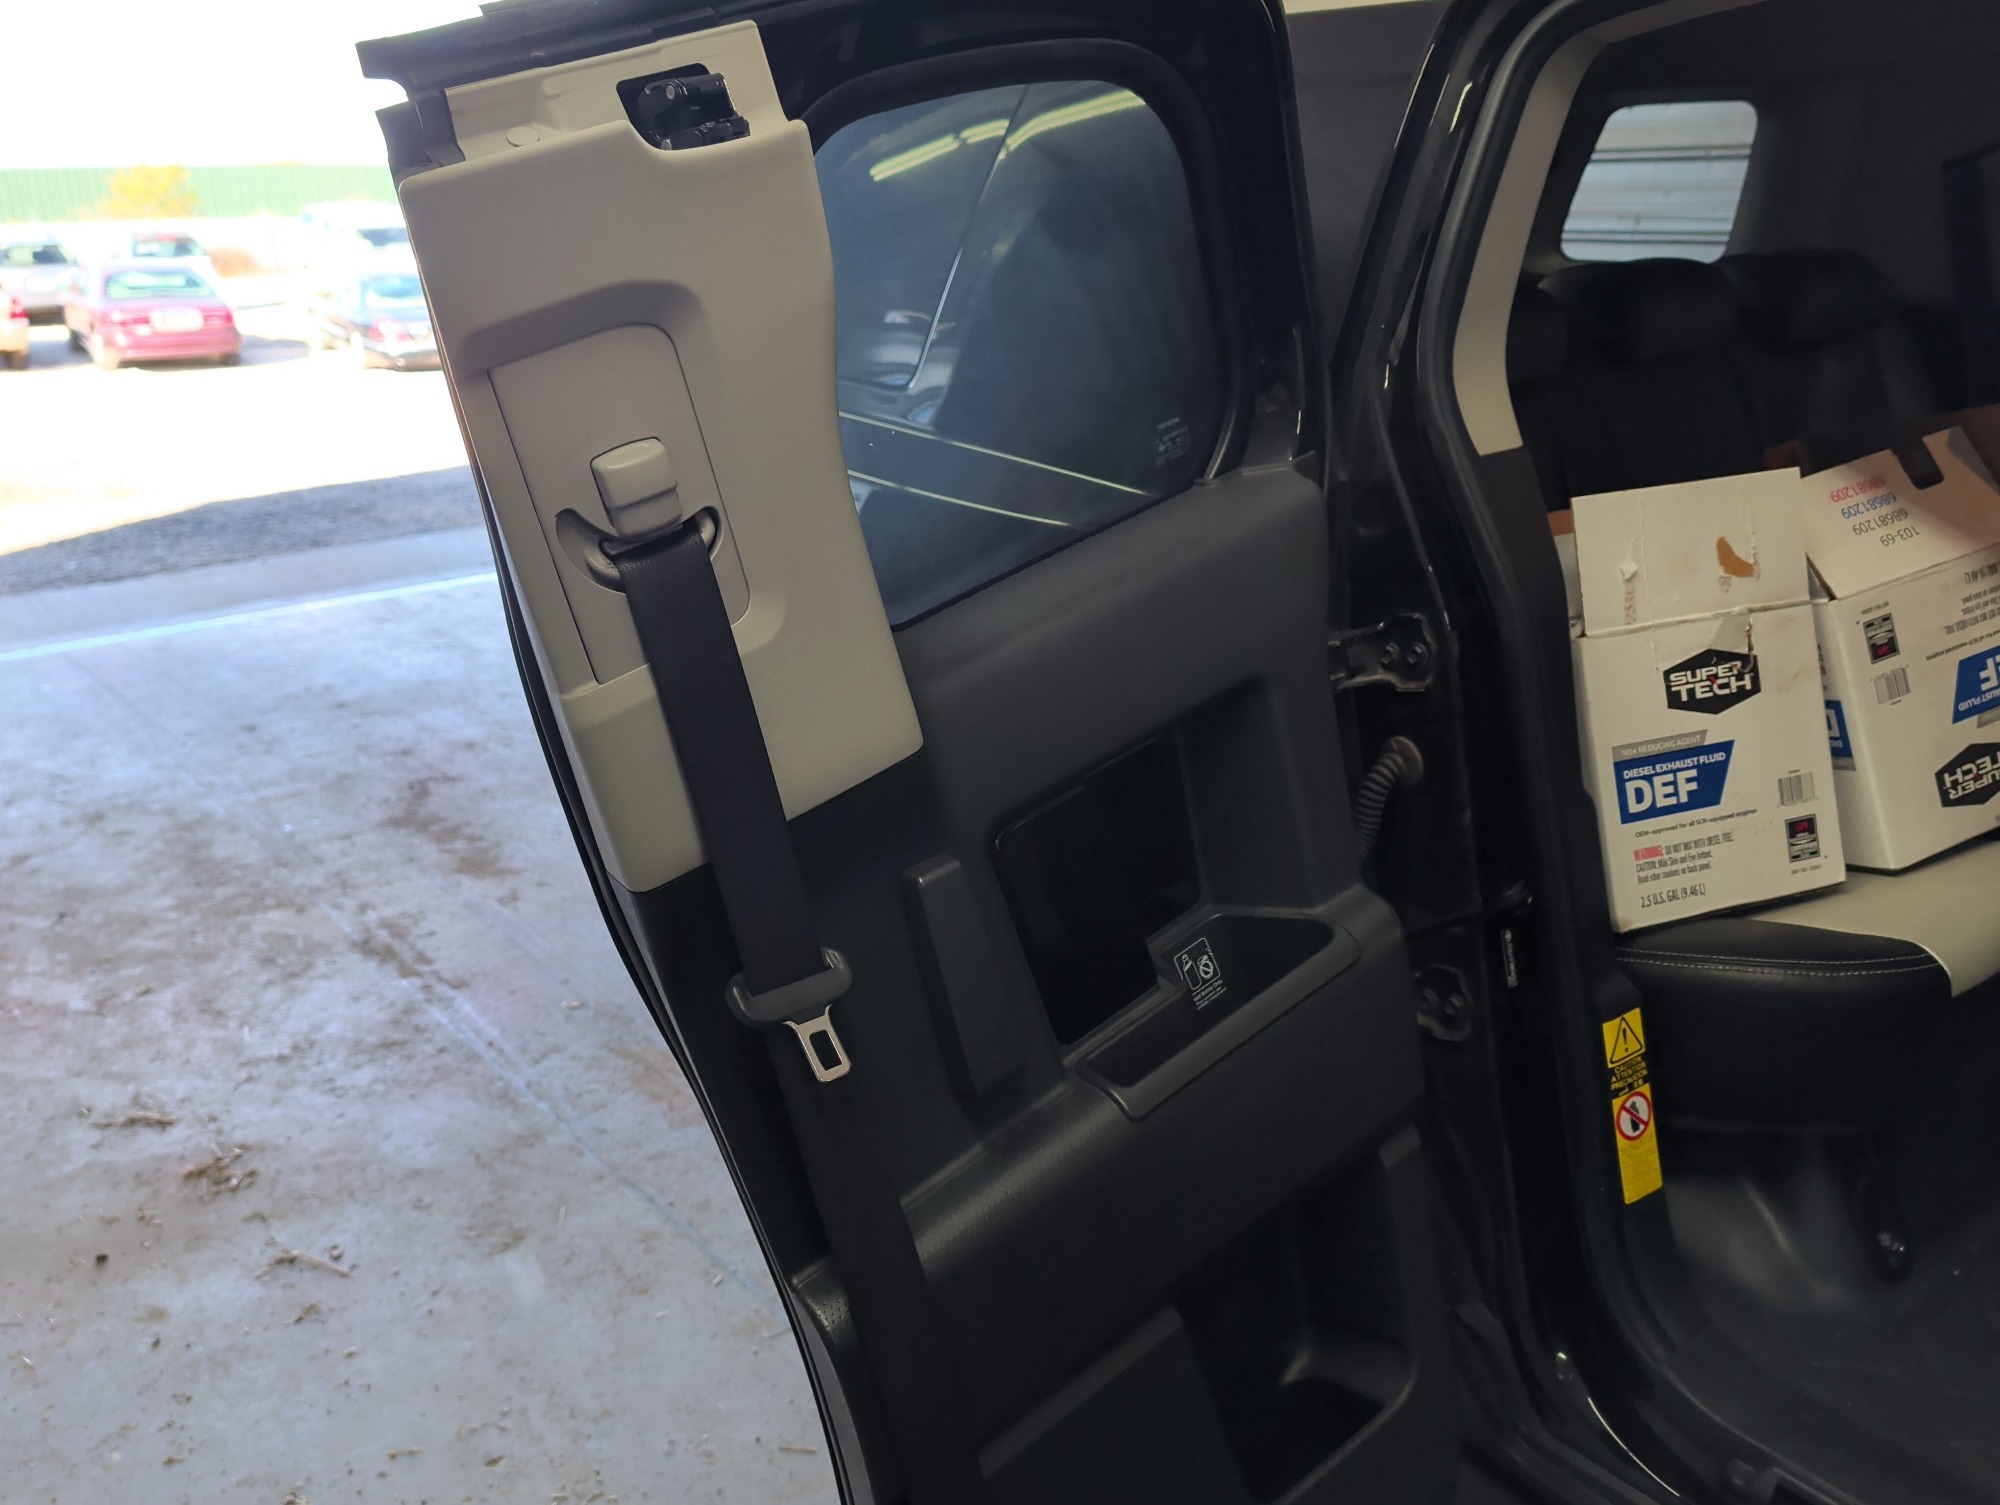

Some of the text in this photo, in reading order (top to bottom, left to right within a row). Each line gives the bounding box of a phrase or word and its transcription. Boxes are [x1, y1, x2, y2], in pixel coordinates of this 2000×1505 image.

[1841, 491, 1897, 519] 68681209
[1852, 508, 1908, 535] 68681209
[1880, 525, 1920, 547] 103-69
[1669, 661, 1743, 686] SUPER
[1671, 673, 1752, 702] TECH
[1958, 696, 1981, 711] FLUID
[1638, 740, 1676, 754] REDUCING
[1676, 735, 1701, 747] AGENT
[1623, 752, 1727, 779] DIESEL EXHAUST FLUID
[1625, 768, 1698, 814] DEF
[1948, 769, 2000, 800] UPER
[1640, 882, 1706, 908] 2.5 U.S. GAL (9.46 L)
[1615, 1056, 1642, 1074] CAUTION
